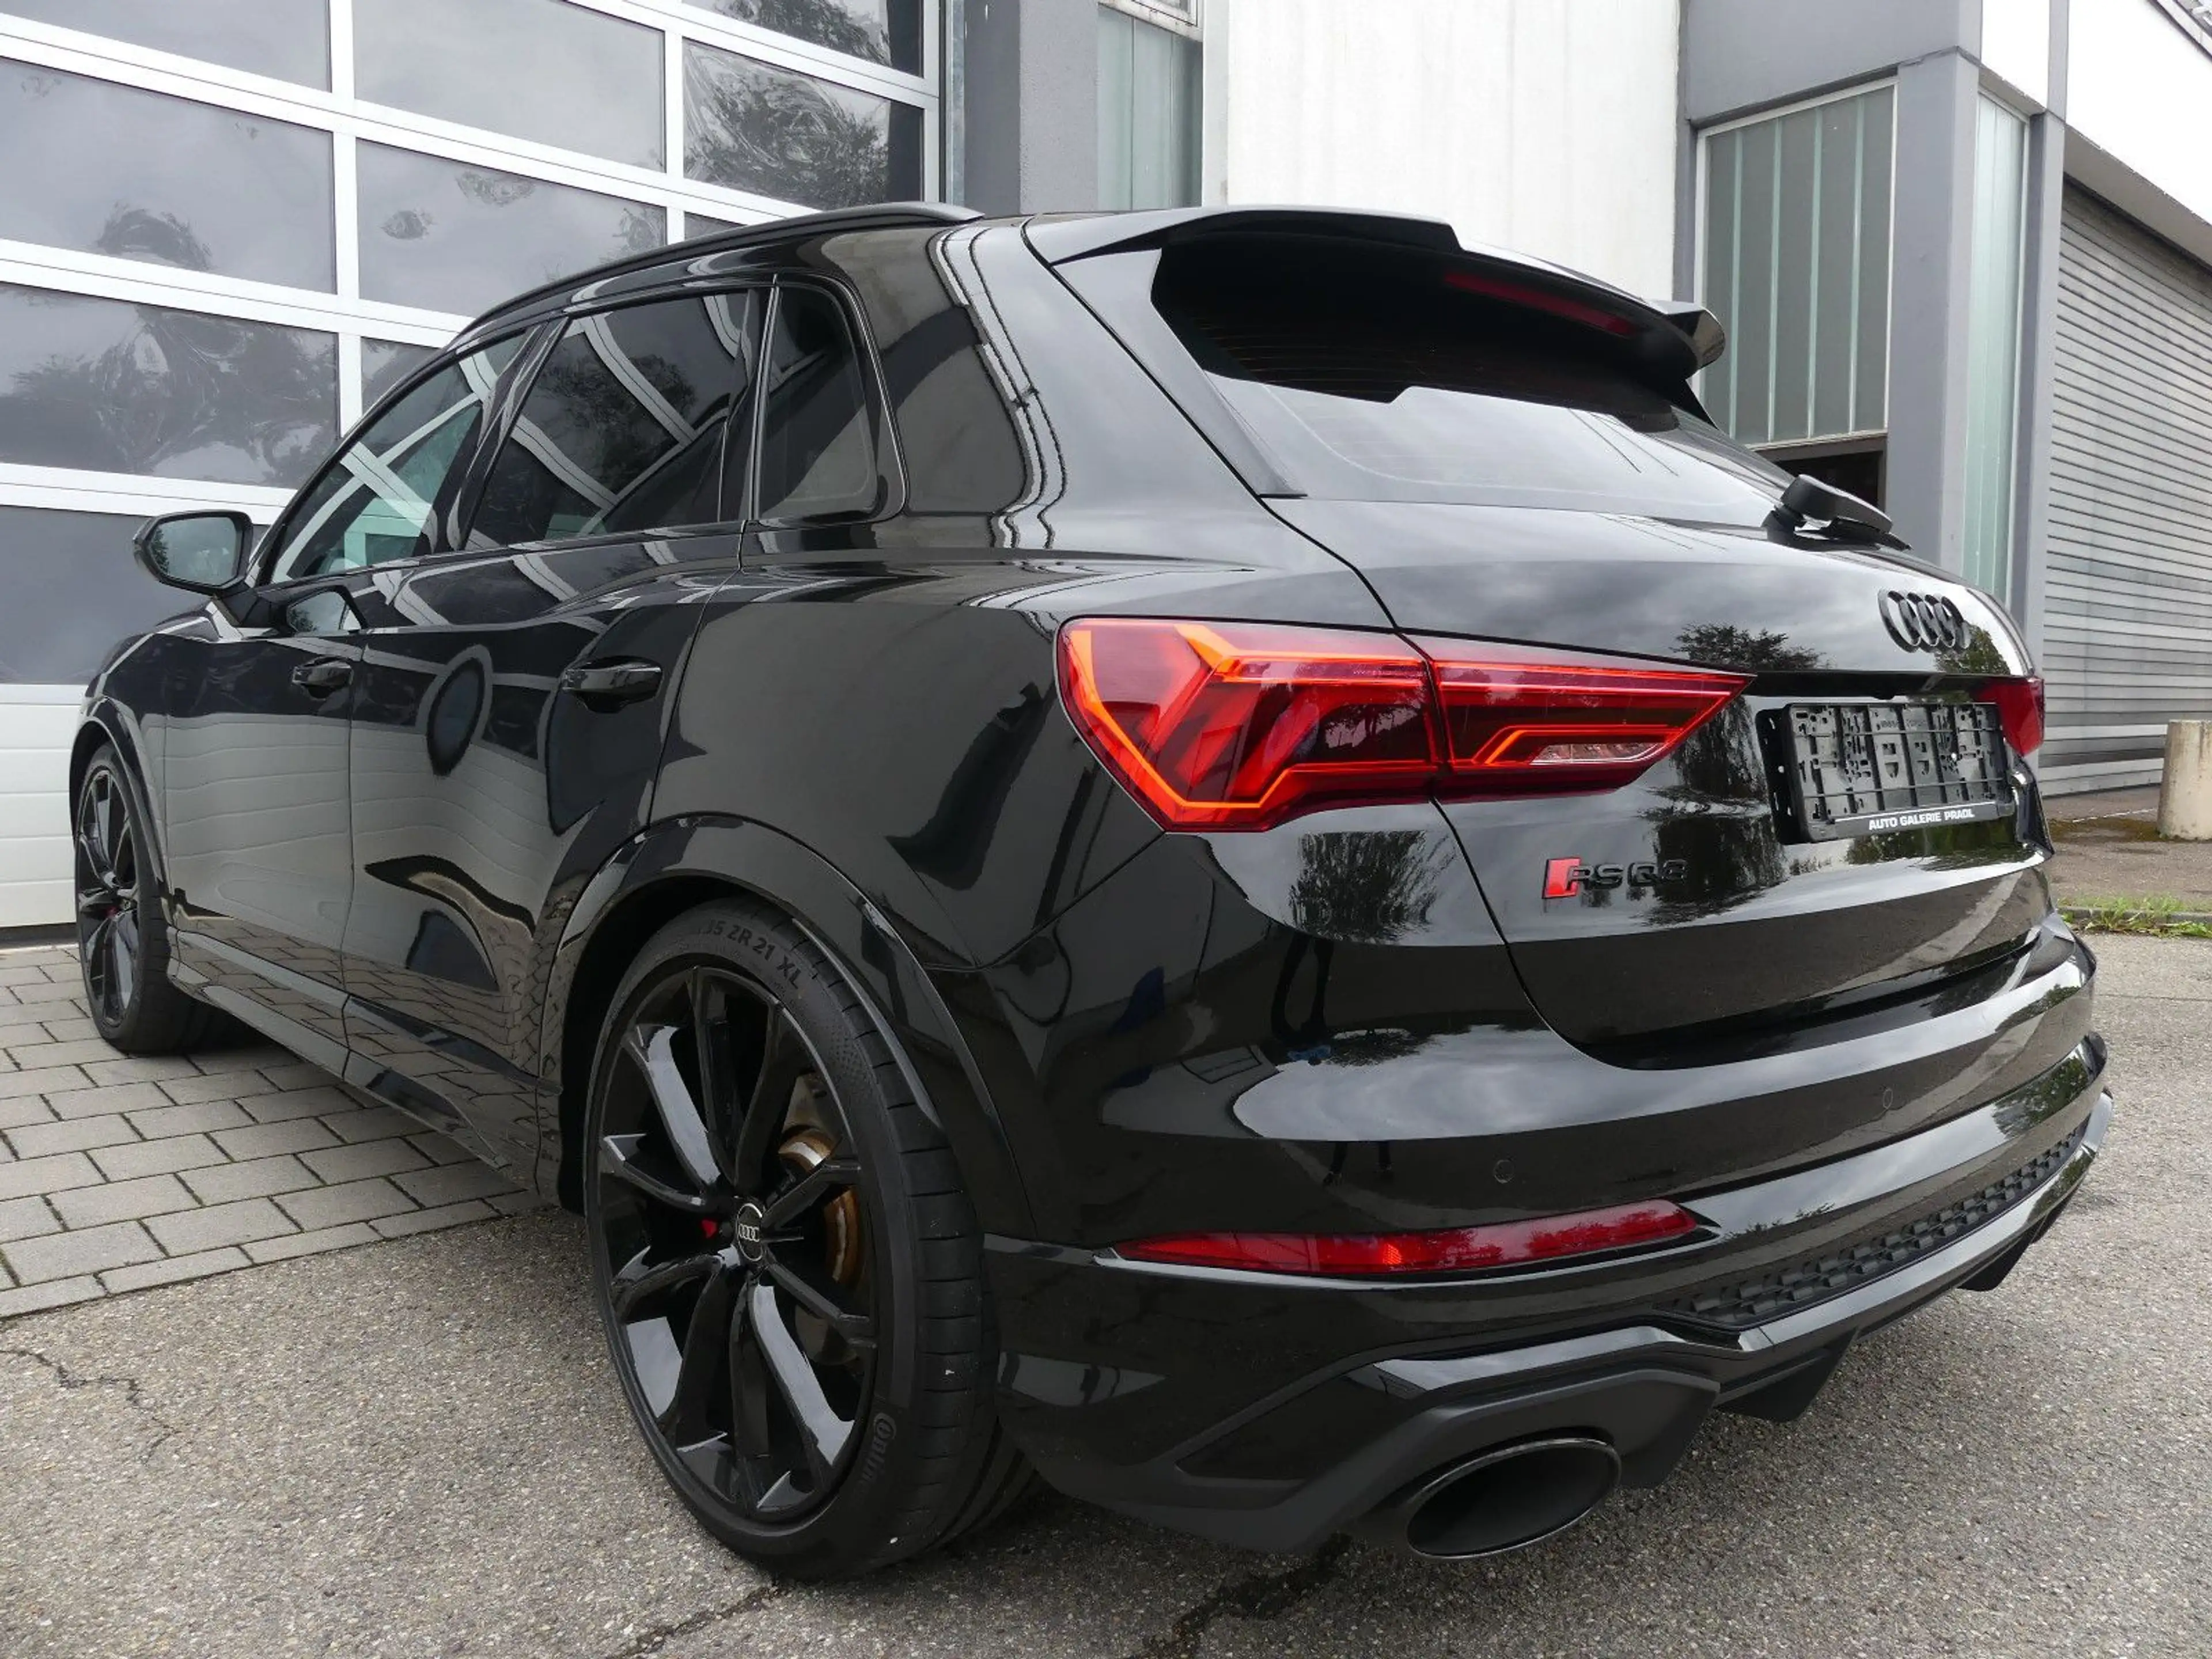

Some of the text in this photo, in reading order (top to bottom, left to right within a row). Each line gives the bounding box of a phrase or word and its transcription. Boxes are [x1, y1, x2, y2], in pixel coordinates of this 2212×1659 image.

[1869, 817, 1897, 830] AUTO
[1900, 812, 1941, 826] GALERIE
[752, 937, 776, 961] 21
[777, 956, 802, 990] XL
